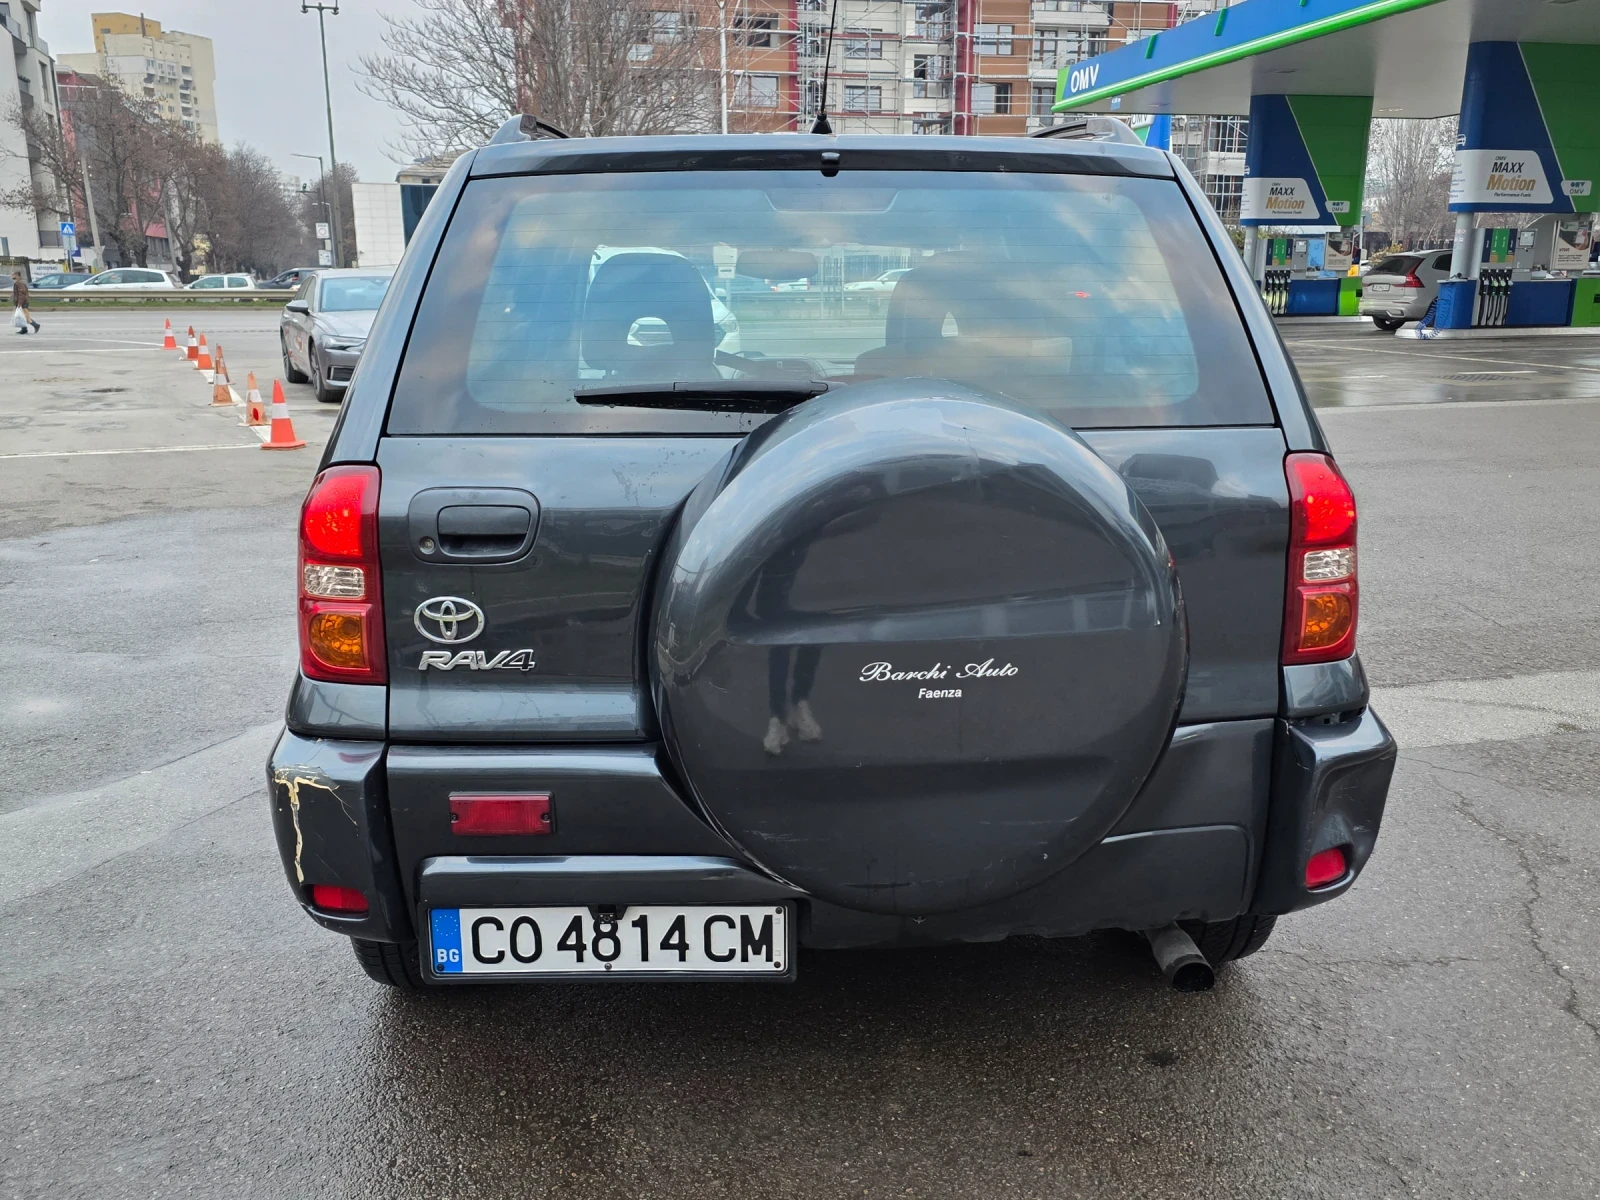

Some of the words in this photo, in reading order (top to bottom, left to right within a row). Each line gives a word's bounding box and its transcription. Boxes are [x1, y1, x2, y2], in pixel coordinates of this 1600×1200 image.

[1070, 63, 1100, 93] OMV
[1491, 162, 1524, 173] MAXX
[1486, 174, 1536, 191] Motion
[1269, 187, 1295, 196] MAXX
[1265, 197, 1305, 210] Motion
[418, 649, 535, 671] RAV4
[859, 661, 951, 682] Barchi
[955, 658, 1018, 679] Auto
[918, 688, 962, 699] Faenza
[471, 915, 543, 964] CO
[556, 914, 690, 963] 4814
[703, 914, 773, 963] CM
[436, 949, 460, 963] BG
